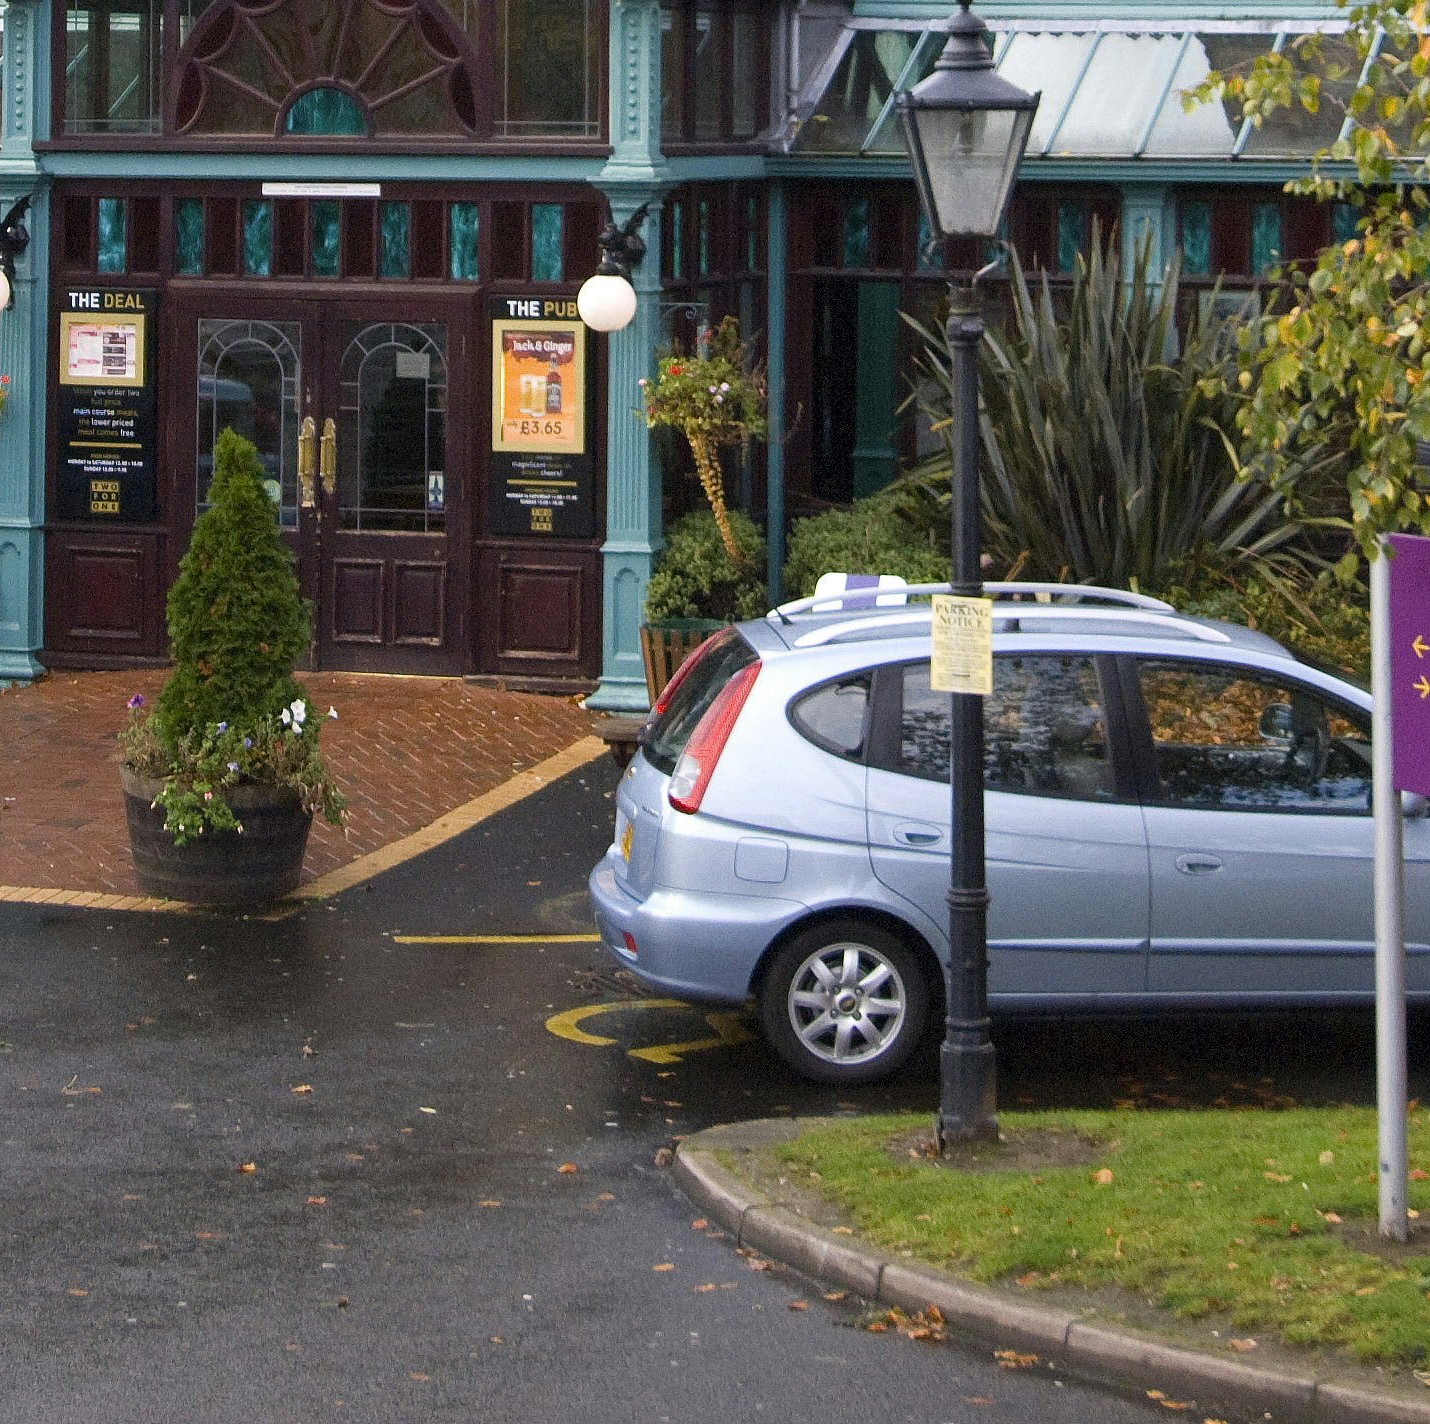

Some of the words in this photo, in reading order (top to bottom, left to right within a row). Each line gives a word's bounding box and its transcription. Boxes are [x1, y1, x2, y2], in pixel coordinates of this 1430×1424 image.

[68, 292, 100, 308] THE
[104, 293, 145, 309] DEAL
[507, 300, 540, 317] THE
[544, 301, 578, 317] PUB
[535, 340, 542, 351] &
[543, 340, 572, 354] Ginger
[91, 418, 110, 426] lower
[111, 418, 134, 427] priced
[521, 421, 562, 435] £3.65
[93, 482, 117, 491] TWO
[93, 493, 116, 501] FOR
[935, 603, 989, 617] PARKING
[940, 616, 982, 627] NOTICE
